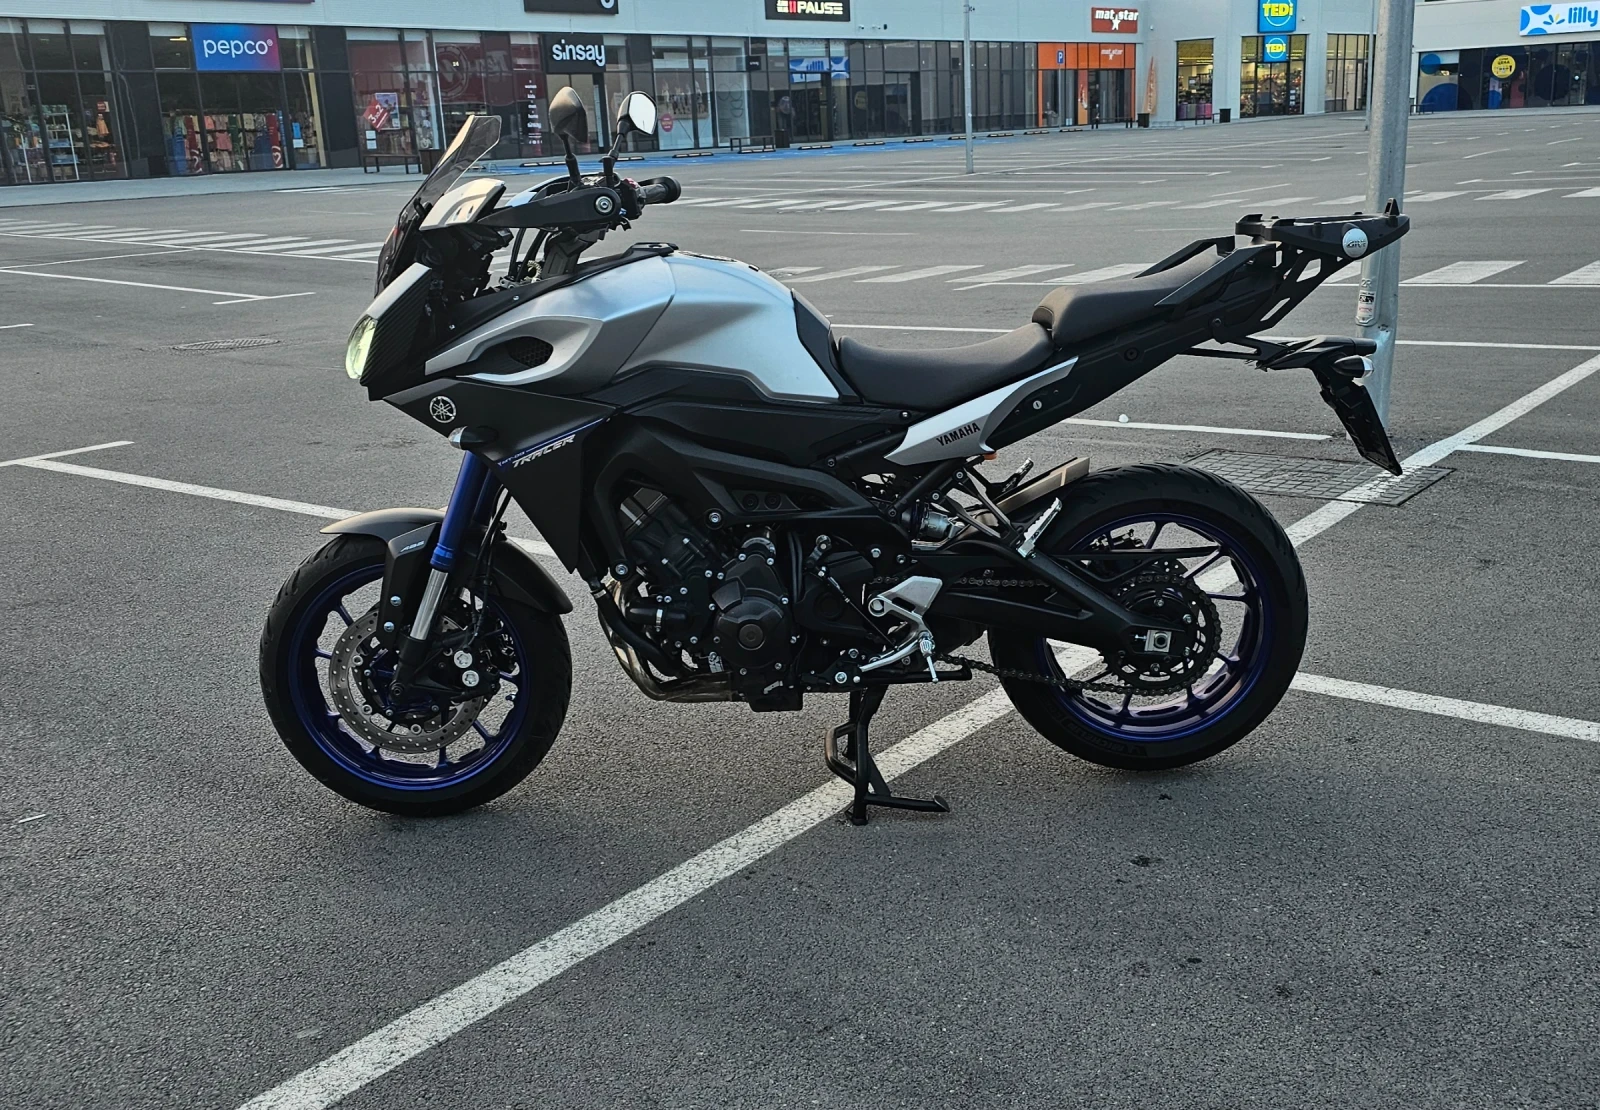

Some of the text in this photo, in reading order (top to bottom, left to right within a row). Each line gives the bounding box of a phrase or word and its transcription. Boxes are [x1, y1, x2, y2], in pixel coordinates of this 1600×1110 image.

[797, 1, 843, 15] PAUSE
[1263, 3, 1294, 17] TEDi
[1568, 6, 1599, 27] lilly
[552, 39, 605, 67] sinsay
[936, 422, 981, 446] YAMAHA
[512, 433, 576, 468] TRACER
[400, 540, 425, 552] ABS
